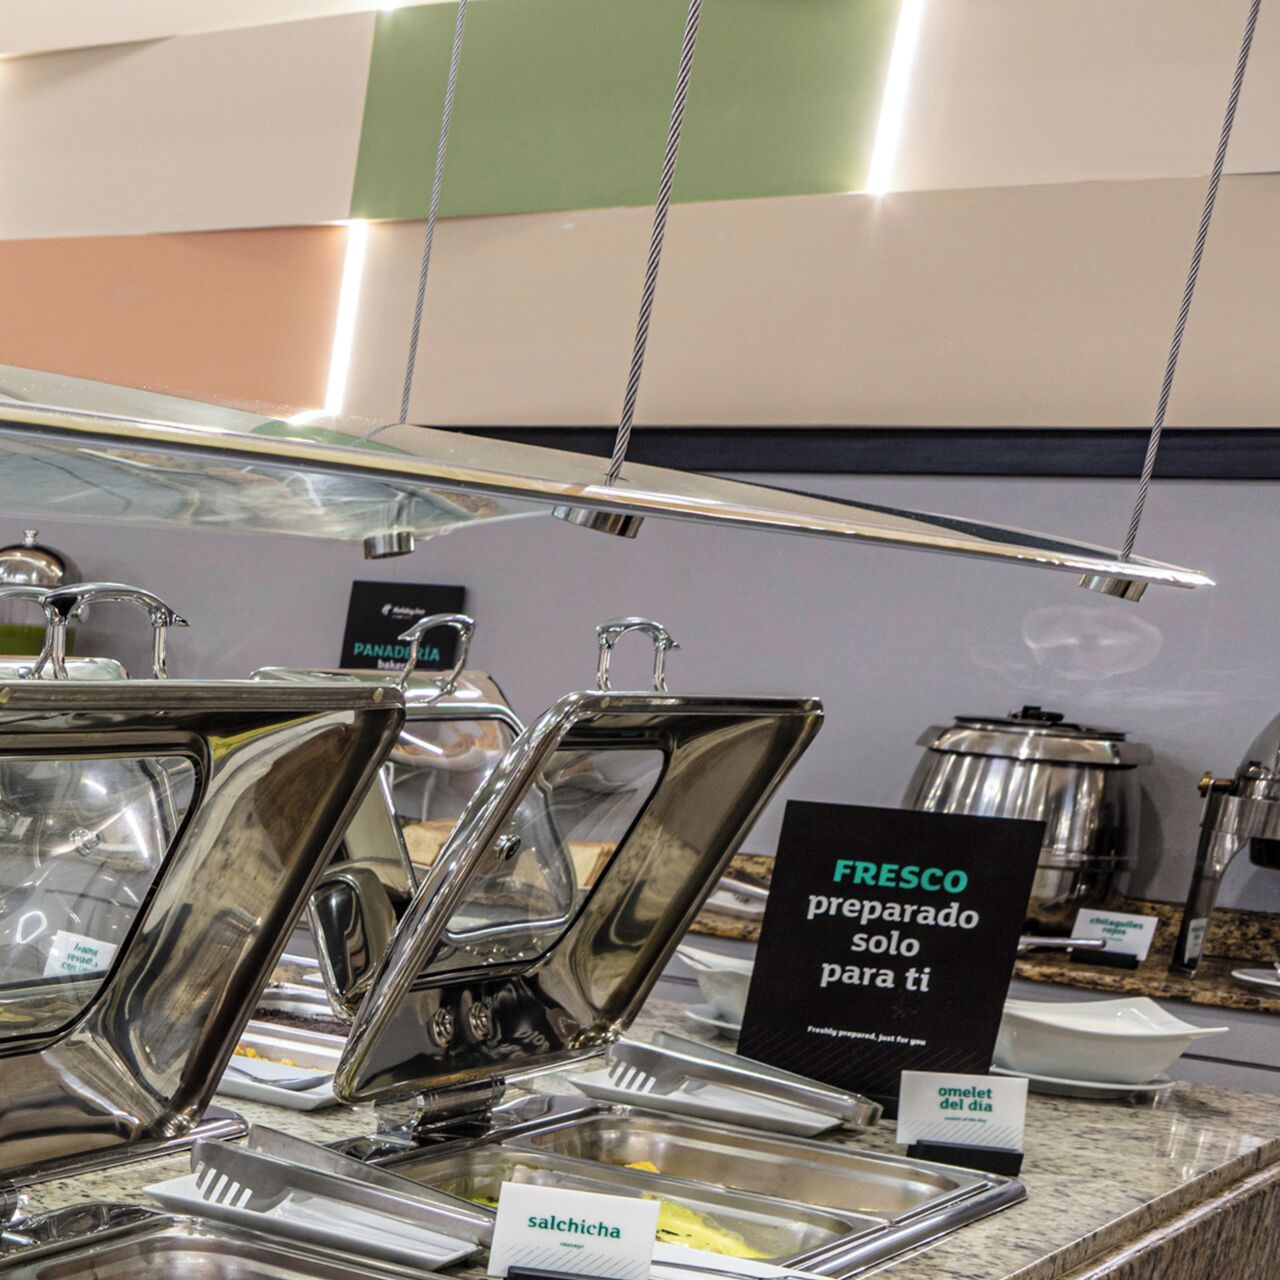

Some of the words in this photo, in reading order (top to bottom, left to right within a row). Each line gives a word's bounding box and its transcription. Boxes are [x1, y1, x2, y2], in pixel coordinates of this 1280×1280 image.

[353, 642, 440, 661] PANADRÍA
[378, 659, 408, 671] baker
[833, 859, 968, 893] FRESCO
[807, 894, 980, 929] preparado
[851, 930, 920, 957] solo
[820, 962, 895, 989] para
[905, 967, 931, 992] ti
[807, 1025, 837, 1037] Freshly
[838, 1030, 877, 1040] prepared,
[877, 1034, 895, 1042] just
[896, 1035, 909, 1043] for
[910, 1038, 926, 1046] you
[938, 1086, 992, 1099] omelet
[940, 1098, 963, 1110] del
[527, 1215, 621, 1239] salchicha
